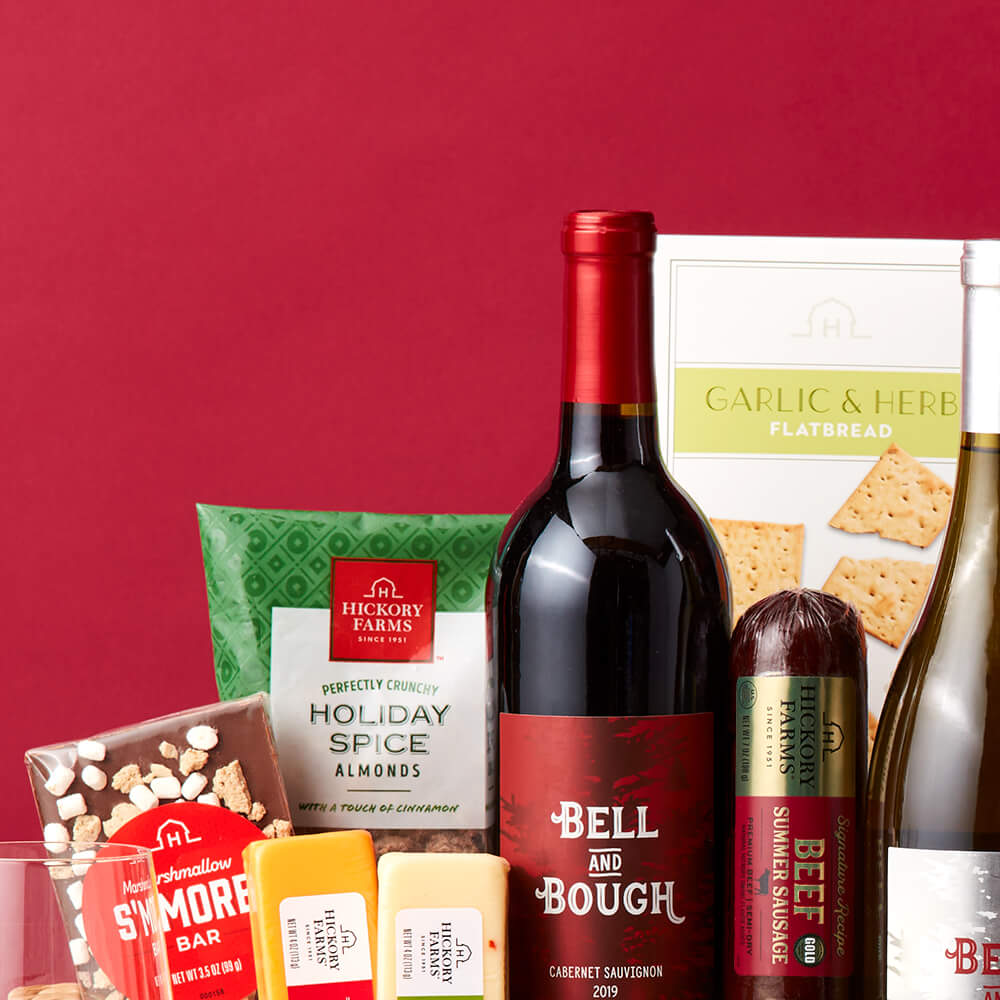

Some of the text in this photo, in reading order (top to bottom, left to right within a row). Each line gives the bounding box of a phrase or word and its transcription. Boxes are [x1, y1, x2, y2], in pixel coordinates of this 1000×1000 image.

[705, 386, 958, 416] GARLIC & HERB
[770, 422, 893, 438] FLATBREAD
[342, 602, 424, 618] HICKORY
[353, 618, 412, 632] FARMS
[388, 636, 407, 644] 1951
[322, 679, 440, 696] PERFECTLY CRUNCHY
[310, 703, 452, 726] HOLIDAY
[329, 733, 430, 755] SPICE
[780, 700, 795, 774] FARMS
[800, 686, 816, 788] HICKORY
[335, 763, 421, 778] ALMONDS
[299, 802, 460, 813] WITH A TOUCH OF CINNAMON
[550, 801, 659, 839] BELL
[588, 854, 622, 872] AND
[772, 806, 790, 964] SUMMER SAUSAGE
[793, 838, 825, 925] BEEF
[832, 815, 850, 956] Signature Recipe
[535, 876, 686, 924] BOUGH
[176, 929, 221, 952] BAR
[314, 920, 327, 965] FARMS
[325, 910, 340, 971] HICKORY
[804, 937, 816, 964] GOLD
[429, 932, 440, 977] FARMS
[441, 922, 452, 984] HICKORY
[185, 968, 198, 982] WT
[199, 965, 210, 979] 3.5
[210, 963, 221, 976] OZ
[549, 965, 663, 979] CABERNET SAUVIGNON
[593, 985, 618, 998] 2019
